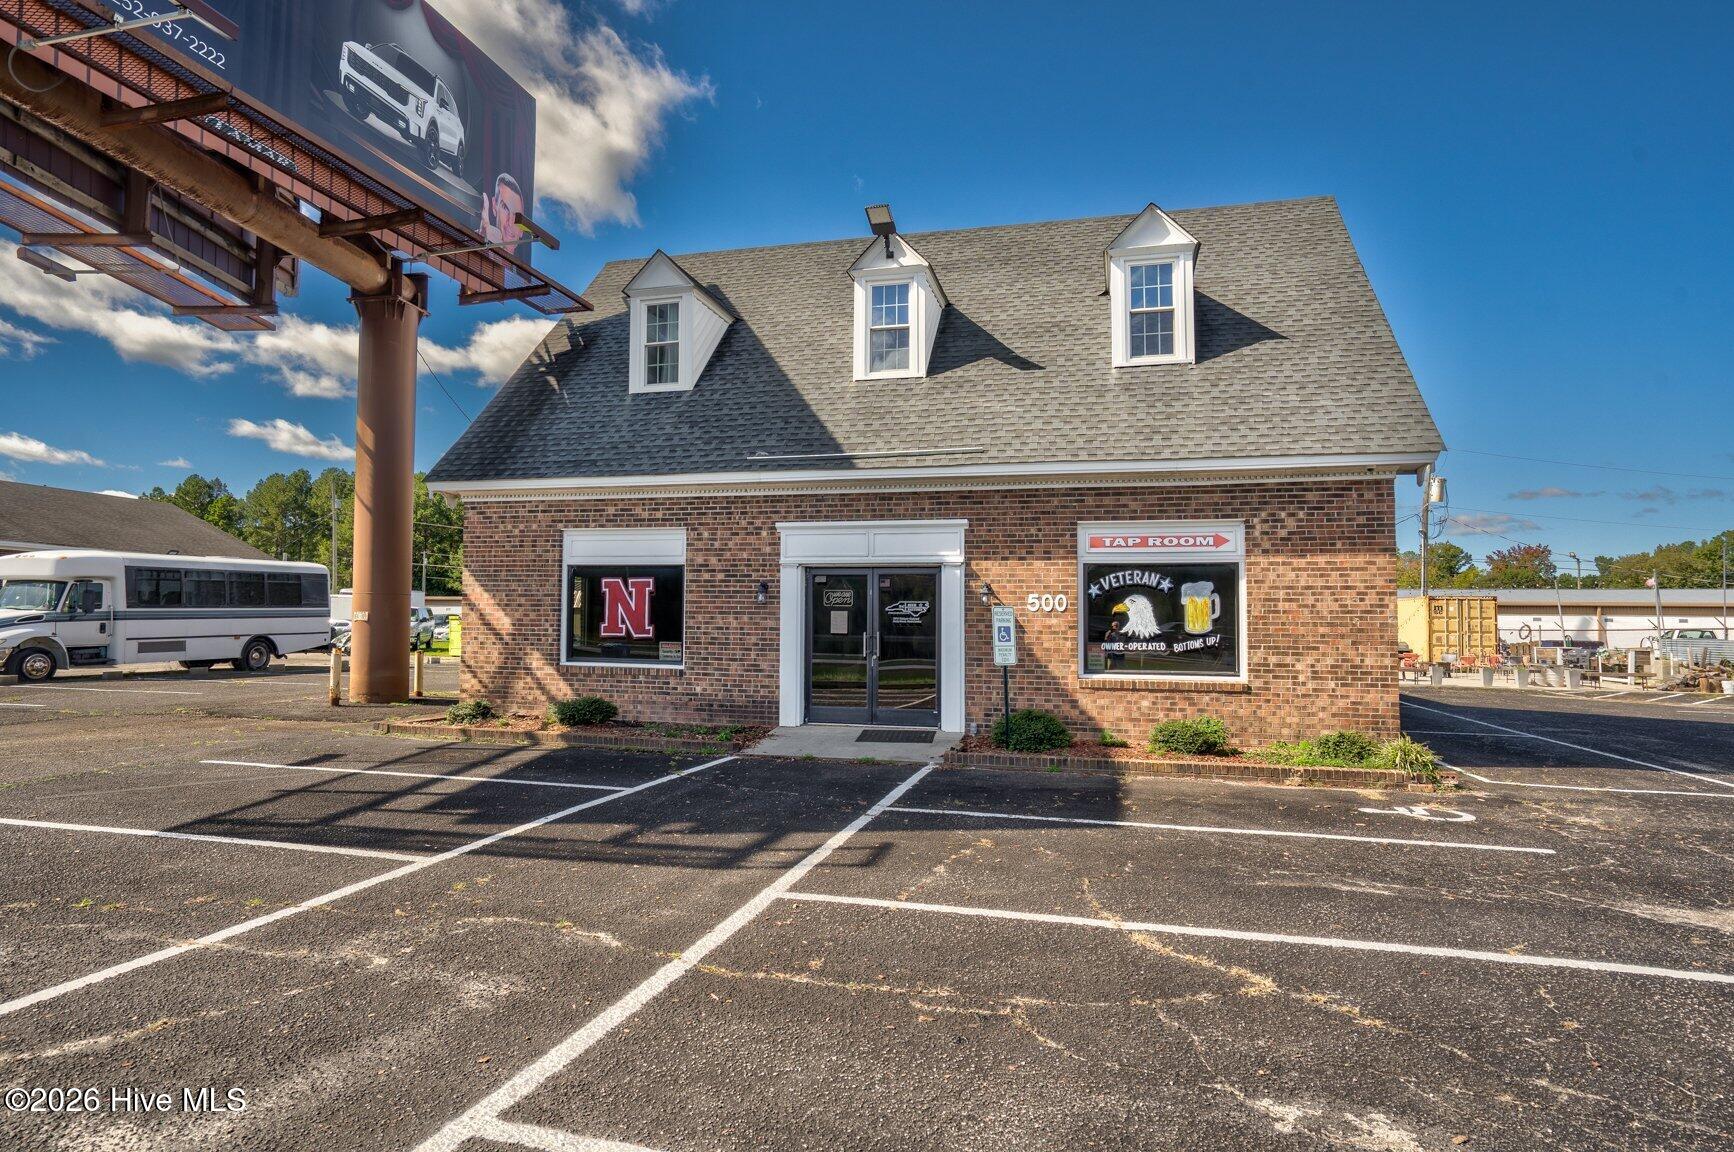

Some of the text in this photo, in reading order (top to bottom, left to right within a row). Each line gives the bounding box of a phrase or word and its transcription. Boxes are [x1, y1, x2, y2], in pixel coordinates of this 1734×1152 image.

[110, 0, 225, 69] 52-37-2222
[1102, 536, 1214, 547] TAP ROOM
[1100, 570, 1160, 591] VETERAN
[600, 577, 655, 639] N
[1026, 593, 1067, 612] 500
[1100, 642, 1166, 651] OWNER-OPERATED
[1173, 634, 1220, 652] BOTTOMS UP!
